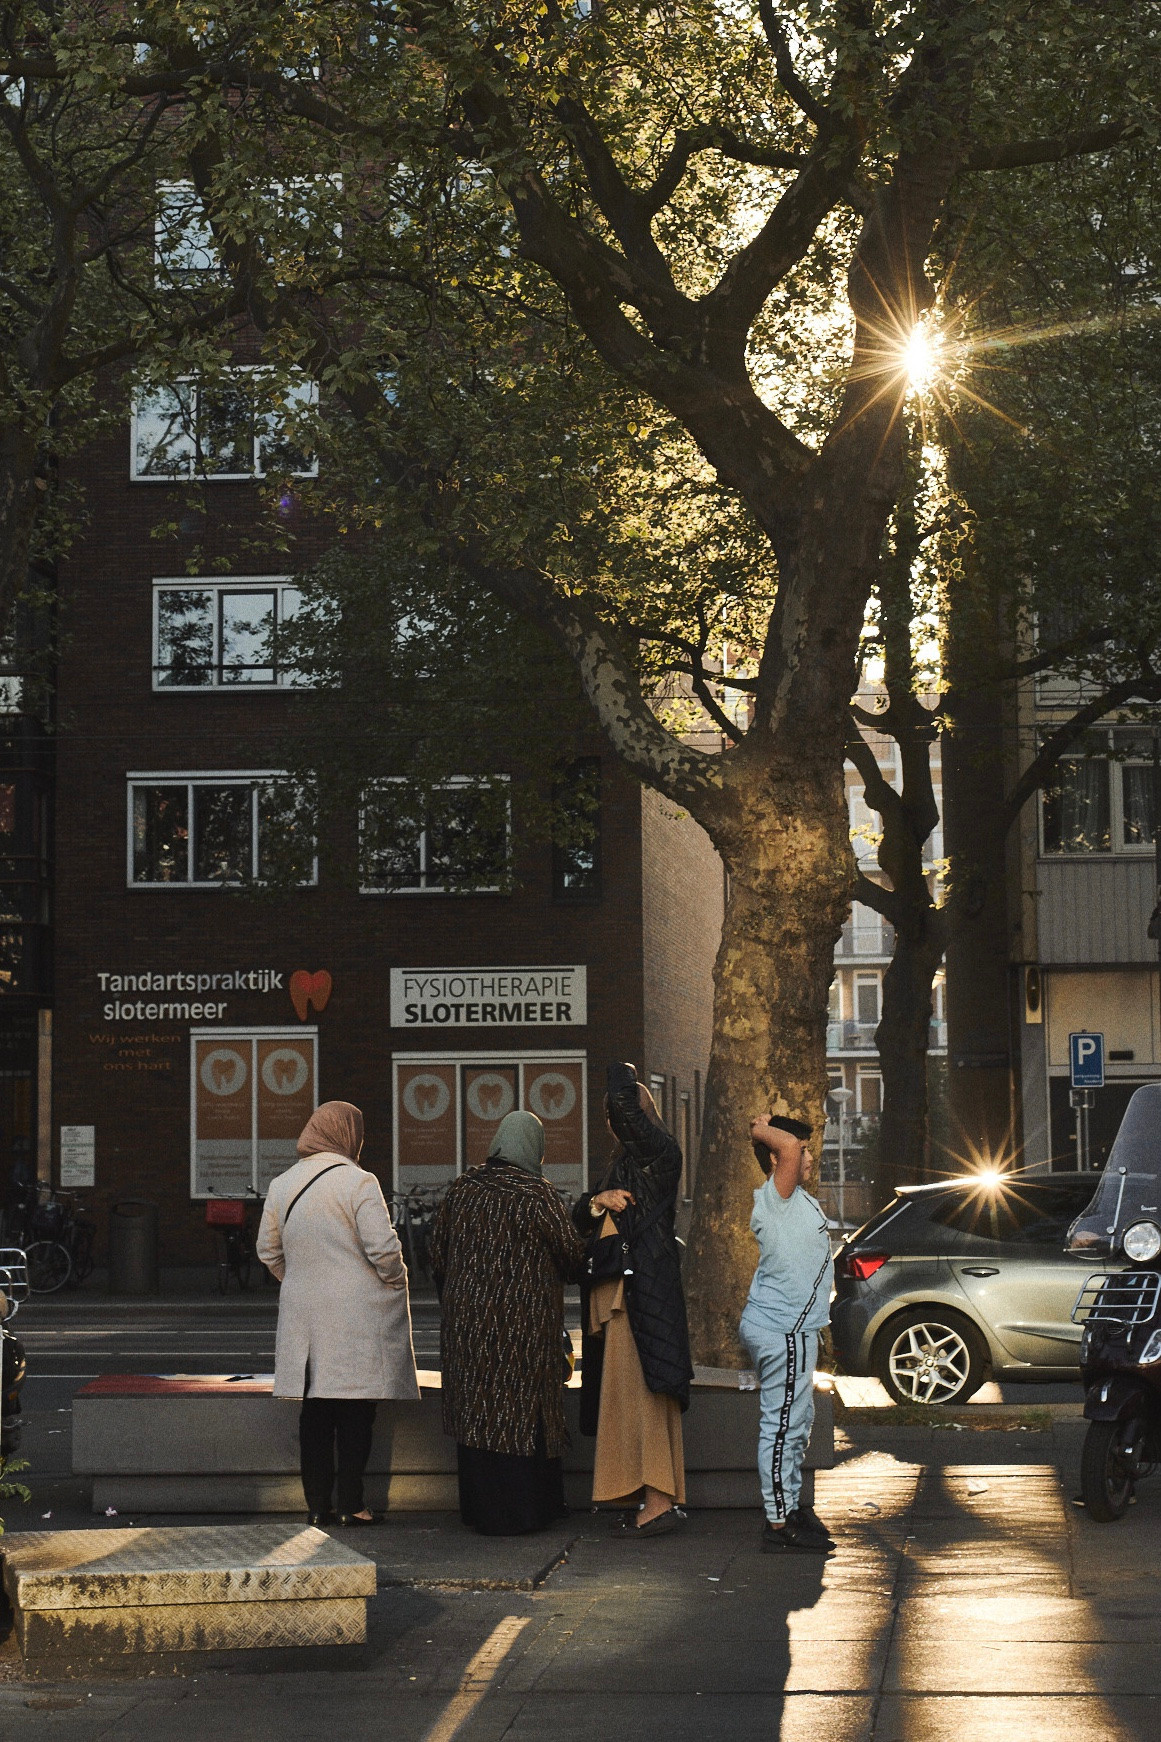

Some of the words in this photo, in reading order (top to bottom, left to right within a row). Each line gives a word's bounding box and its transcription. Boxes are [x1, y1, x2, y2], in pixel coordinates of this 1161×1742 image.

[97, 969, 283, 993] Tandartspraktijk
[404, 976, 572, 998] FYSIOTHERAPIE
[103, 1000, 228, 1020] slotermeer
[404, 1002, 572, 1024] SLOTERMEER
[89, 1034, 115, 1045] Wij
[120, 1033, 182, 1044] werken
[118, 1048, 152, 1057] met
[1078, 1038, 1096, 1065] P
